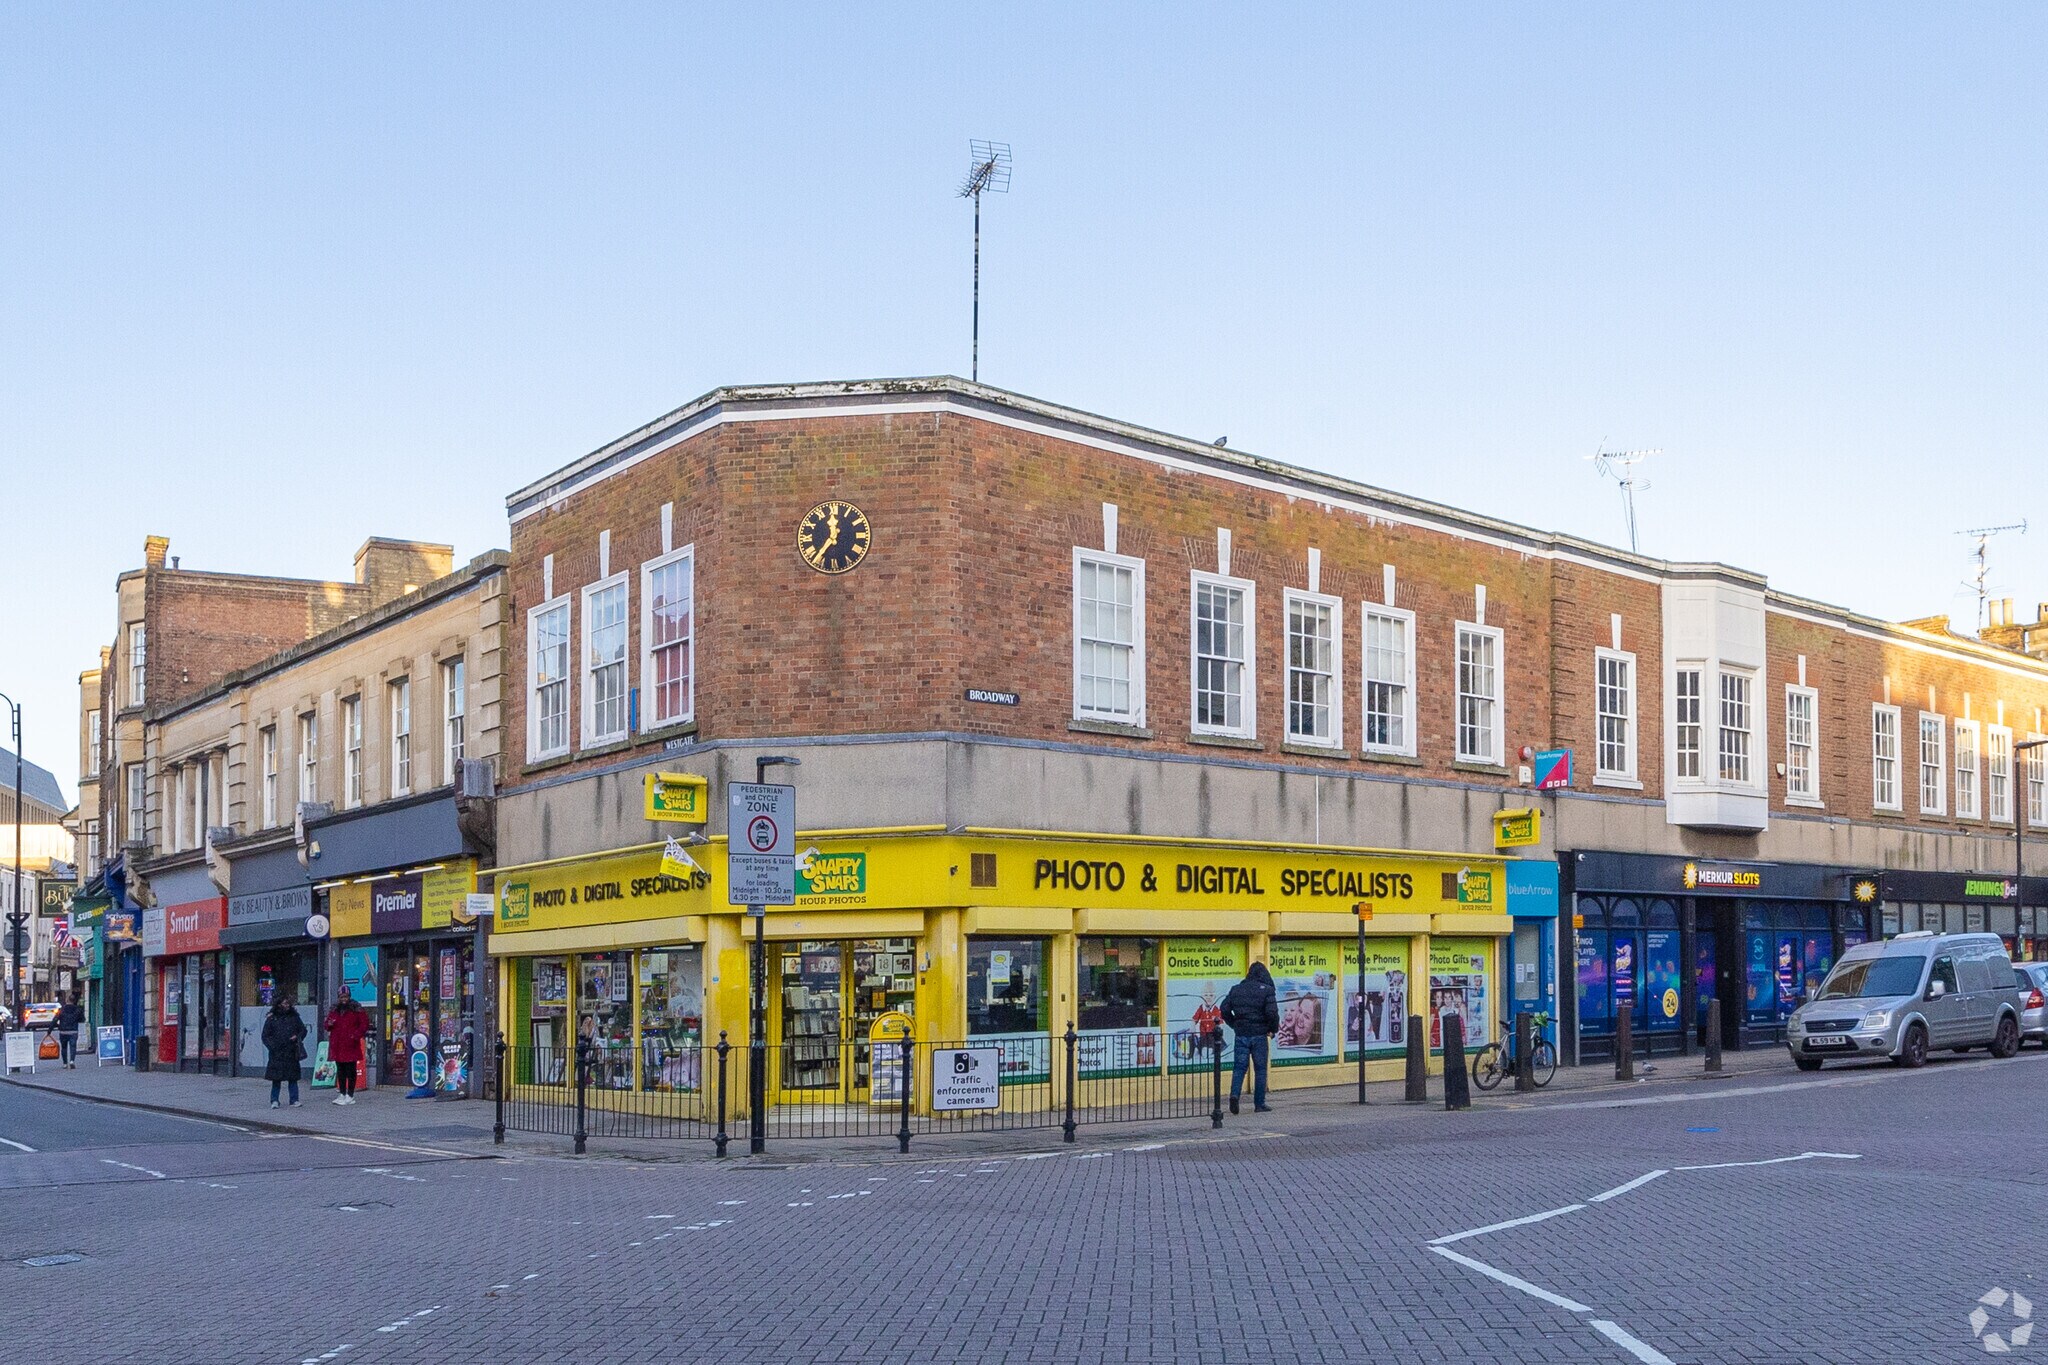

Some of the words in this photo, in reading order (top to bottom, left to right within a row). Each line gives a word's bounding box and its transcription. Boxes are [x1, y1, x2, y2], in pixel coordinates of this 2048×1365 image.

[970, 690, 1015, 704] BROADWAY
[666, 735, 694, 750] WESTGATE
[658, 784, 693, 800] SNAPPY
[740, 785, 783, 795] PEDESTRIAN
[664, 798, 692, 810] SNAPS
[758, 794, 778, 802] CYCLE
[746, 802, 777, 813] ZONE
[731, 856, 753, 865] Except
[754, 856, 772, 864] buses
[802, 856, 862, 880] SNAPPY
[756, 880, 779, 888] loading
[810, 874, 860, 894] SNAPS
[1034, 859, 1125, 892] PHOTO
[1140, 863, 1158, 892] &
[1176, 864, 1264, 895] DIGITAL
[1280, 868, 1414, 899] SPECIALISTS
[1462, 873, 1490, 891] SNAPPY
[1698, 870, 1733, 884] MERKUR
[1734, 872, 1760, 885] SLOTS
[533, 888, 565, 908] PHOTO
[571, 887, 578, 904] &
[584, 881, 624, 902] DIGITAL
[631, 872, 705, 897] SPECIALISTS
[732, 886, 759, 895] Midnight
[1467, 888, 1488, 902] SNAPS
[1508, 883, 1553, 896] blueArrow
[247, 898, 273, 913] BEAUTY
[274, 896, 282, 909] &
[282, 890, 308, 908] BROWS
[376, 892, 417, 913] Premier
[765, 894, 791, 902] Midnight
[828, 896, 867, 904] PHOTOS
[336, 900, 347, 914] City
[349, 899, 364, 910] News
[170, 909, 198, 934] Smart
[1168, 956, 1200, 968] Onsite
[1202, 956, 1233, 967] Studio
[1270, 955, 1296, 969] Digital
[1300, 955, 1306, 966] &
[1309, 955, 1327, 966] Film
[1374, 954, 1400, 964] Phones
[1430, 954, 1450, 964] Photo
[1453, 954, 1469, 964] Gifts
[1666, 998, 1674, 1007] 24
[951, 1076, 981, 1085] Traffic
[937, 1085, 995, 1095] enforcement
